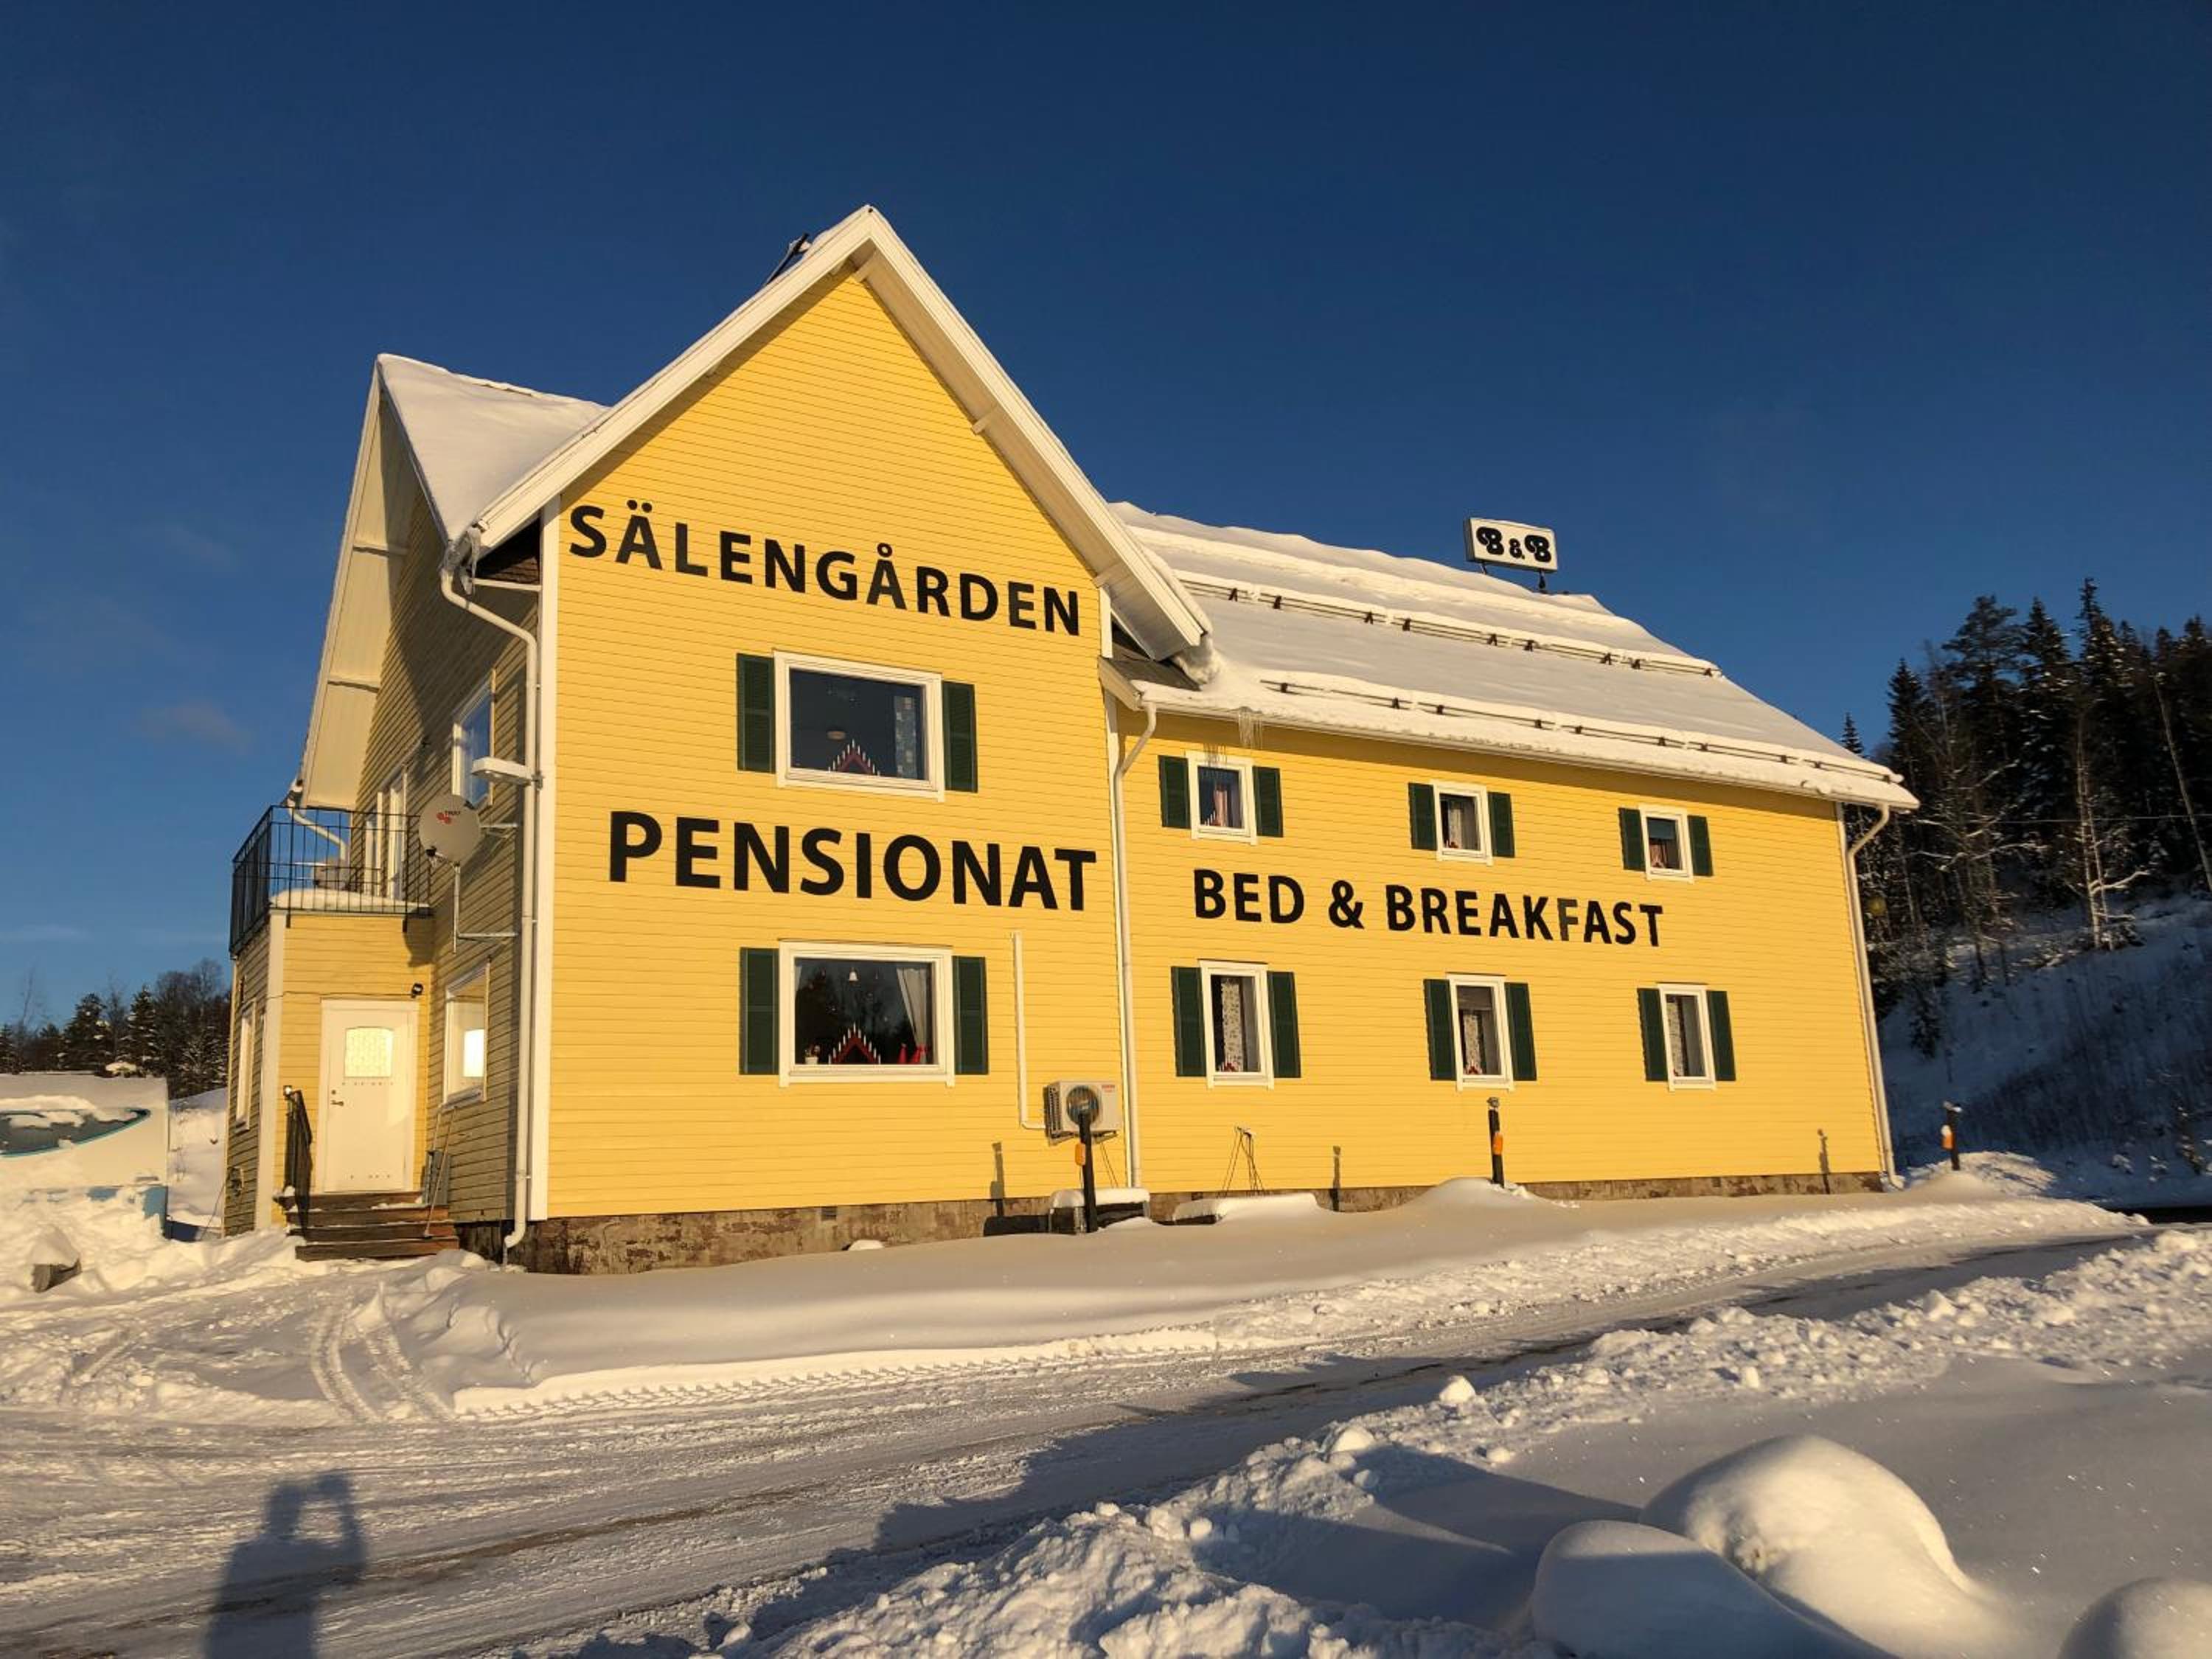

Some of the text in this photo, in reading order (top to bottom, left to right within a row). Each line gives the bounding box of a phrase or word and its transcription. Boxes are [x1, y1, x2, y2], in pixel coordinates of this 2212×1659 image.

[569, 499, 1079, 636] SÄLENGÅRDEN
[609, 810, 1097, 911] PENSIONAT
[1193, 869, 1663, 947] BED & BREAKFAST
